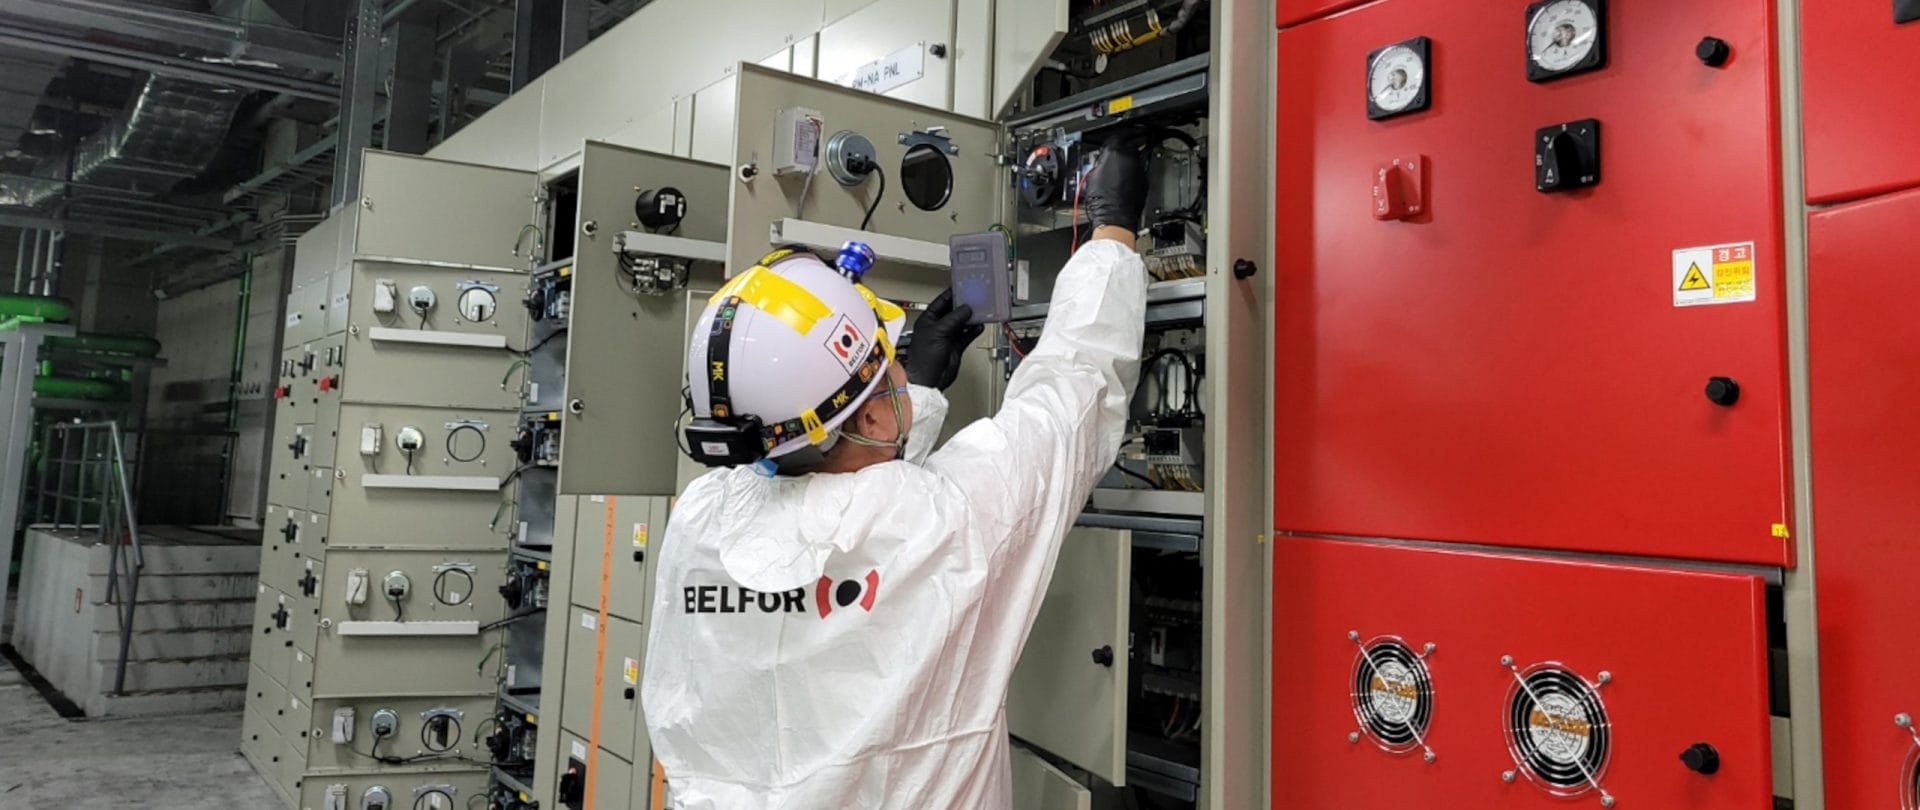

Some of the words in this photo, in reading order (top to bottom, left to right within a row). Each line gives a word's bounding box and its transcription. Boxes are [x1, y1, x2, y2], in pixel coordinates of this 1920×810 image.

[883, 62, 900, 80] PNL
[1719, 247, 1746, 262] 경고
[849, 342, 866, 368] BELFOR
[712, 361, 725, 381] MK
[833, 391, 849, 408] MK
[684, 586, 806, 614] BELFOR
